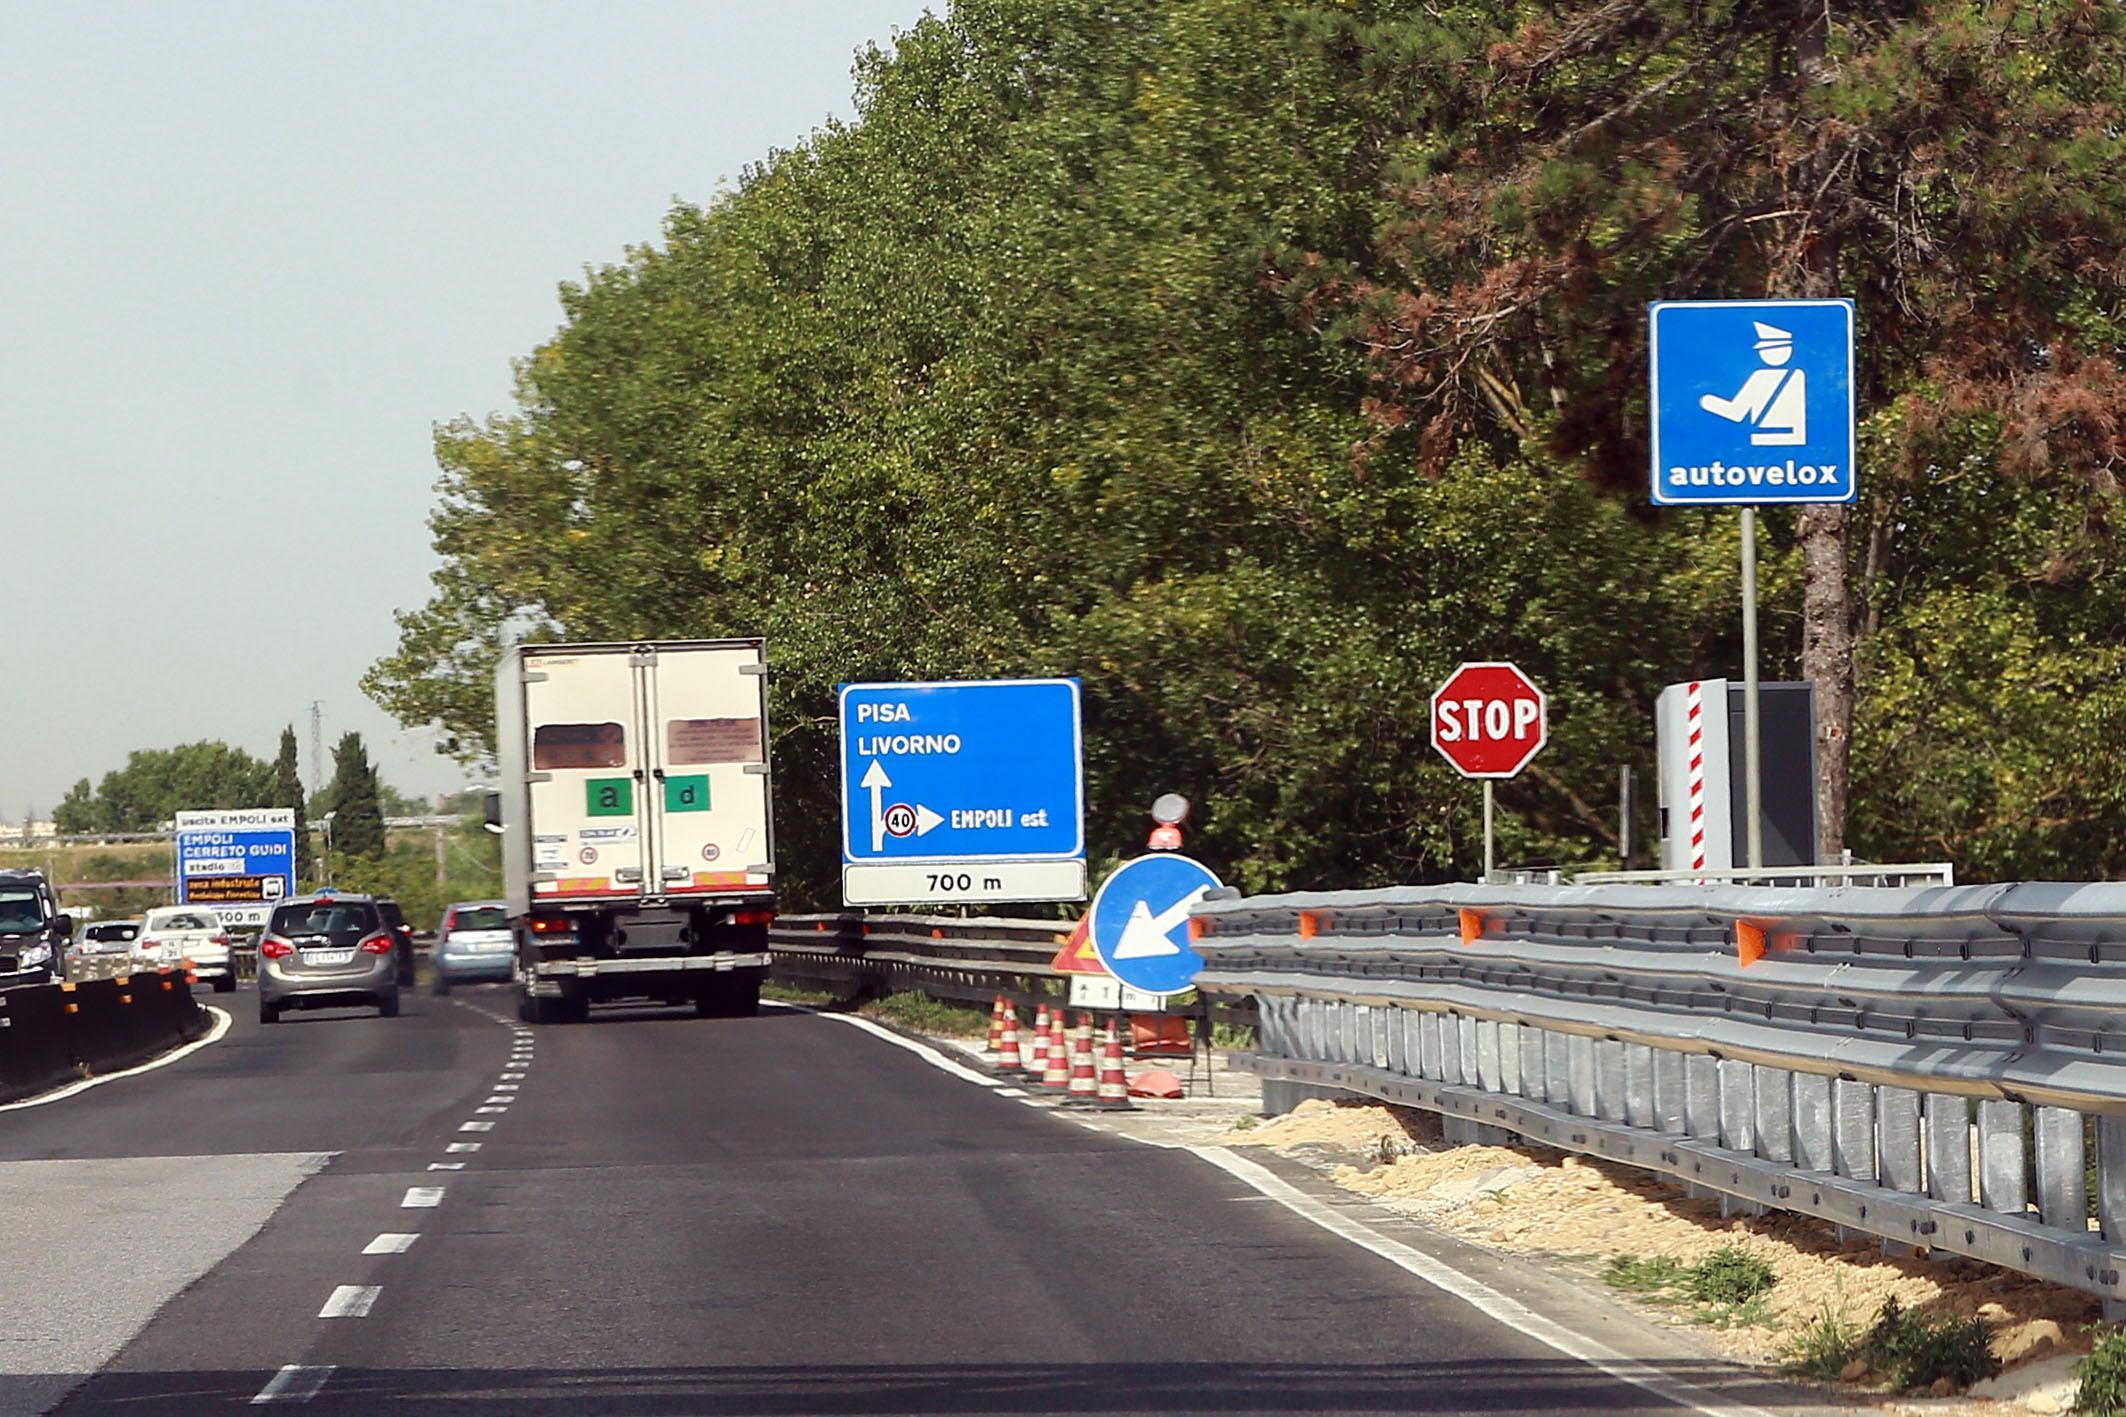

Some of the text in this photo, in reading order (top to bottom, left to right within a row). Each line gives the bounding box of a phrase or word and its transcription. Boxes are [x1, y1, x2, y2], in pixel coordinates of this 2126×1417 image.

[1669, 461, 1839, 487] autovelox
[857, 703, 911, 723] PISA
[1438, 698, 1538, 741] STOP
[858, 735, 962, 755] LIVORNO
[599, 786, 620, 808] a
[680, 785, 695, 804] d
[182, 817, 216, 826] uscita
[221, 815, 266, 825] EMPOLI
[891, 813, 909, 828] 40
[951, 809, 1049, 829] EMPOLI est
[183, 834, 232, 846] EMPOLI
[183, 844, 287, 858] CERRETO GUIDI
[189, 862, 225, 872] stadio
[927, 874, 1001, 892] 700 m
[248, 912, 260, 922] m
